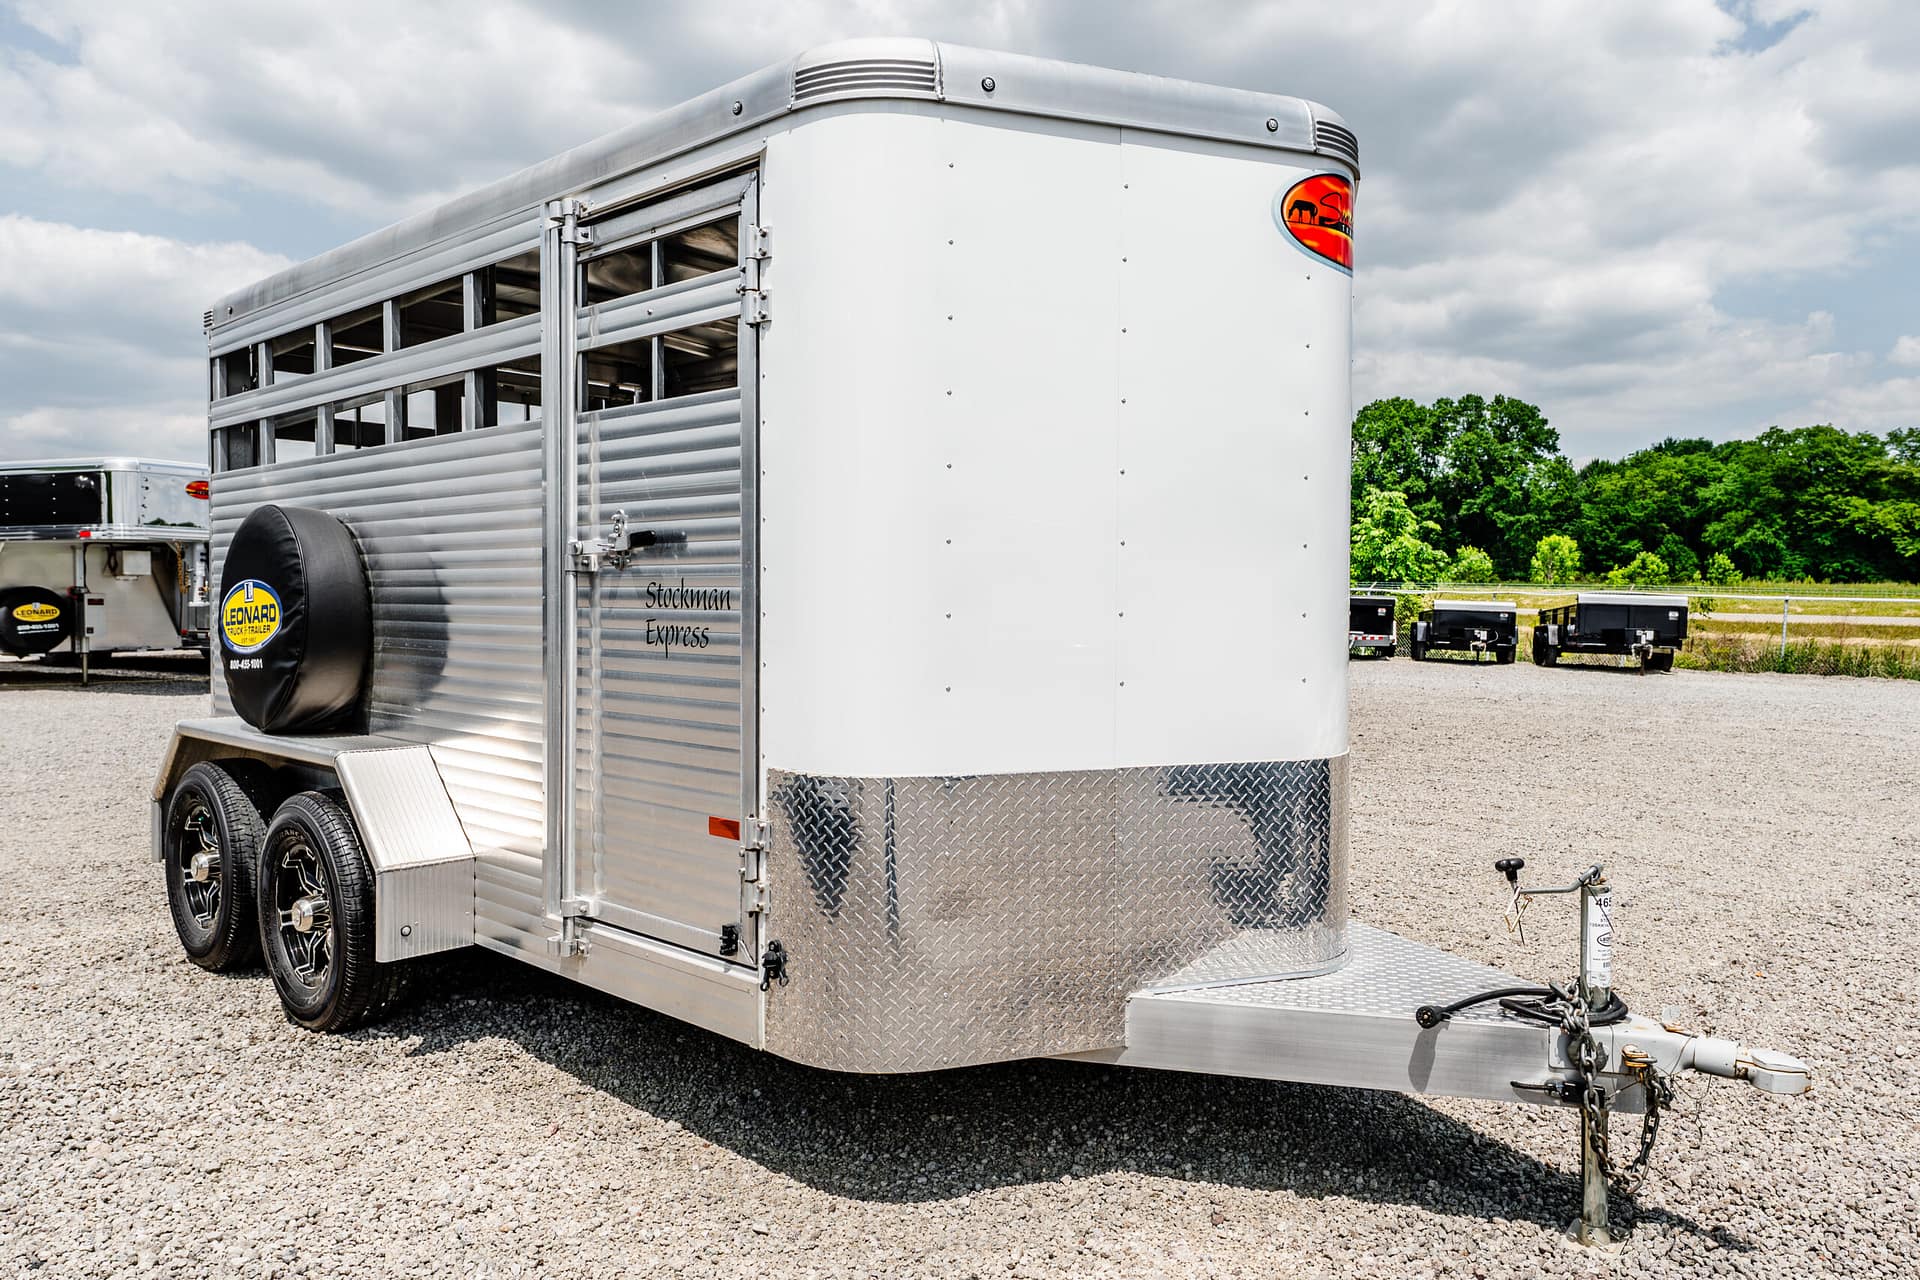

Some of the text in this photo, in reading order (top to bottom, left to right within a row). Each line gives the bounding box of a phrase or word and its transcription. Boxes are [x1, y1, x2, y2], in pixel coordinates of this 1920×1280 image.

[645, 577, 731, 610] Stockman
[225, 604, 276, 626] LEONARD
[248, 625, 270, 635] TRAILER
[645, 619, 709, 658] Express
